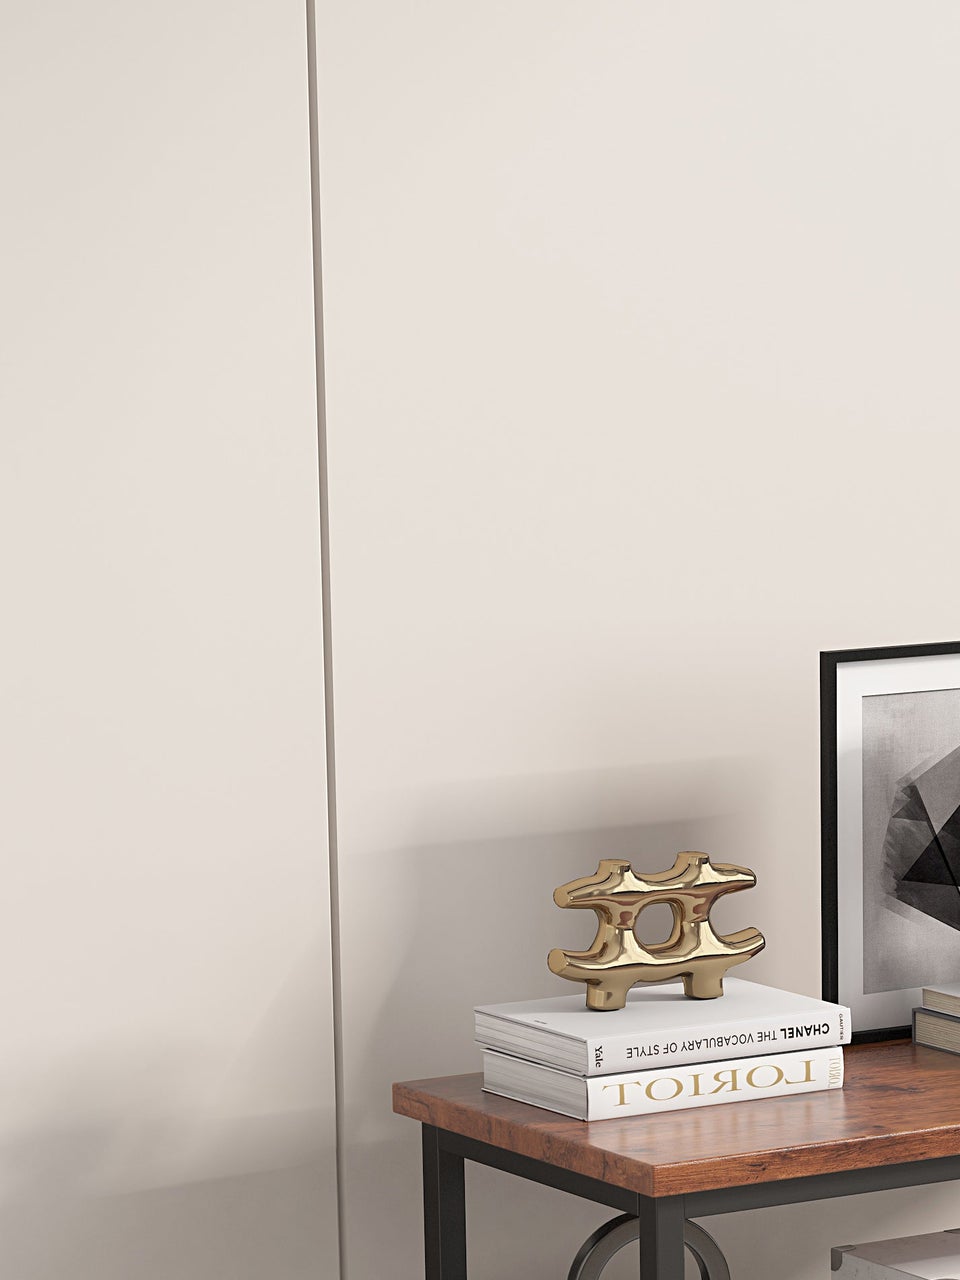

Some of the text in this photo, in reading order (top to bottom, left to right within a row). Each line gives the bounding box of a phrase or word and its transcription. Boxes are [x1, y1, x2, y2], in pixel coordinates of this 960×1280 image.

[626, 1022, 830, 1059] CHANEL THE VOCABULARY OF STYLE
[594, 1045, 604, 1068] Yale
